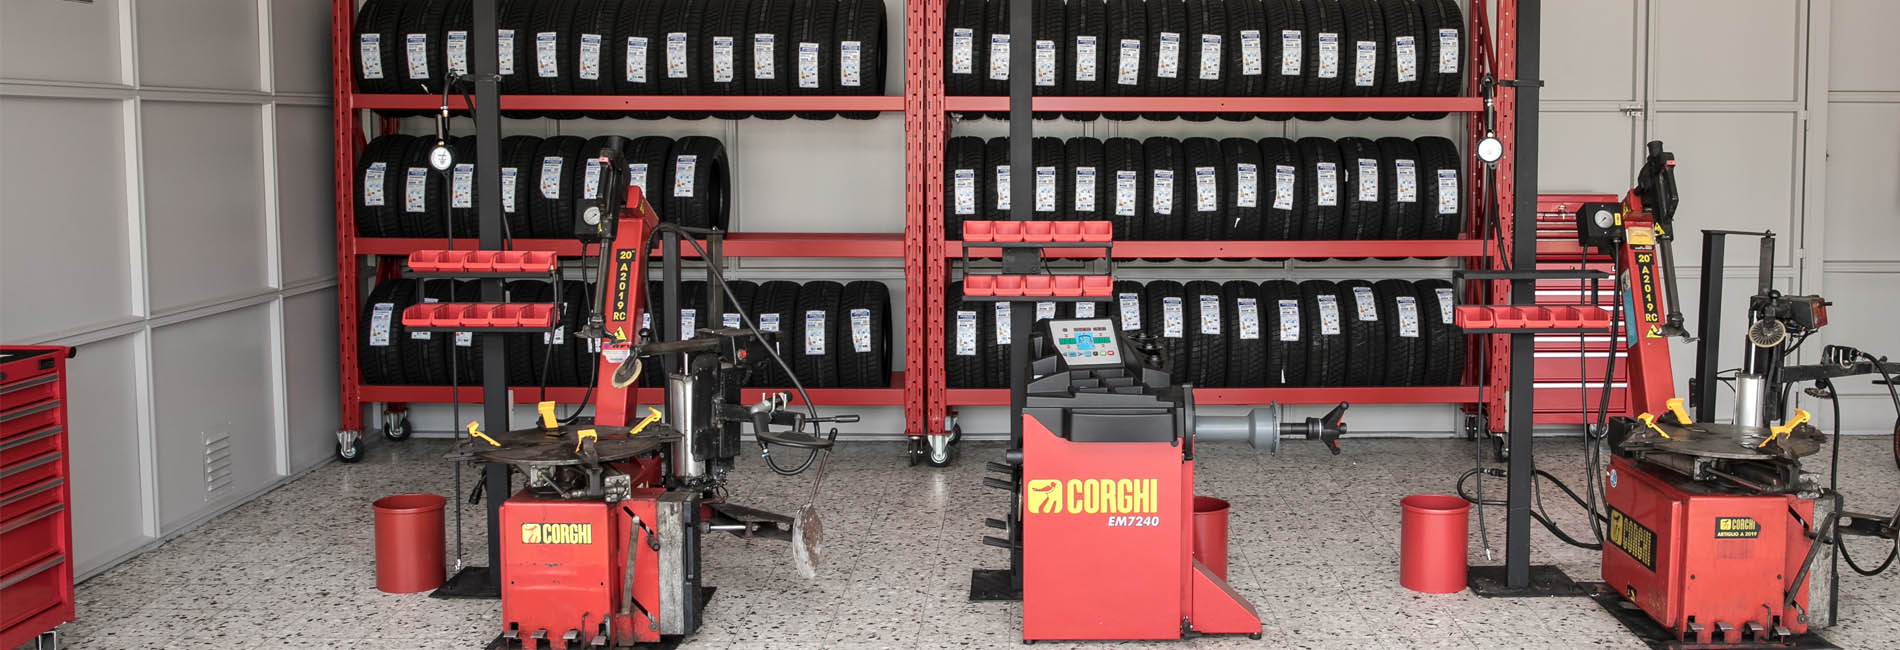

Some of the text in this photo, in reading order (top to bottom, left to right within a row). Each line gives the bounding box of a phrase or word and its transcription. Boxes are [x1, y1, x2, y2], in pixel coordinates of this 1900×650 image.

[617, 263, 629, 310] A2019
[1642, 265, 1654, 312] A2019
[613, 311, 626, 321] RC
[1645, 313, 1658, 322] RC
[1067, 478, 1158, 514] CORGHI
[1107, 516, 1160, 527] EM7240
[1731, 518, 1756, 531] CORGHI
[542, 523, 592, 544] CORGHI
[1622, 516, 1653, 567] CORGHI
